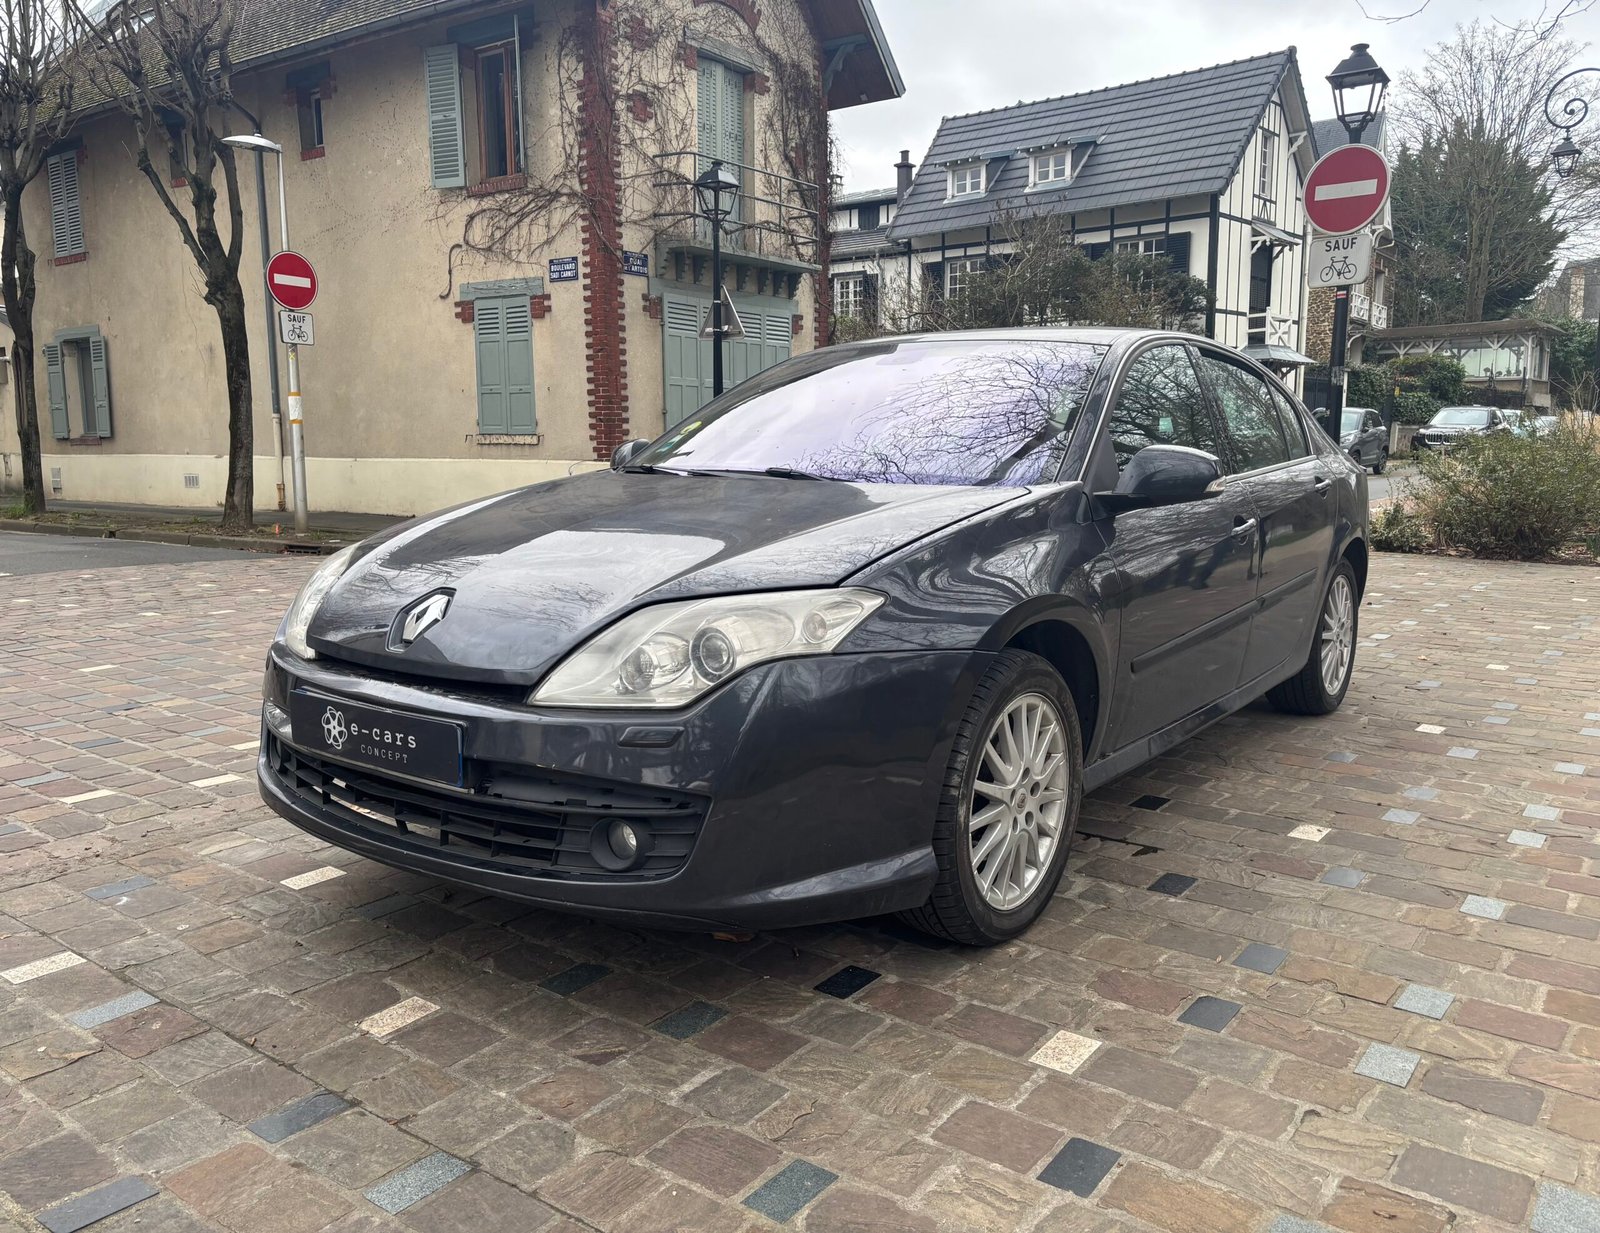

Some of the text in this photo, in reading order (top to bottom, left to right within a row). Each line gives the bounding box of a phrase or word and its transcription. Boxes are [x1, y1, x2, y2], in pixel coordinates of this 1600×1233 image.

[1325, 237, 1358, 252] SAUF
[550, 263, 576, 272] BOULEVARD
[550, 270, 576, 279] SADI CARNOT
[287, 314, 306, 324] SAUF
[350, 722, 417, 749] e-cars
[360, 744, 408, 764] CONCEPT
